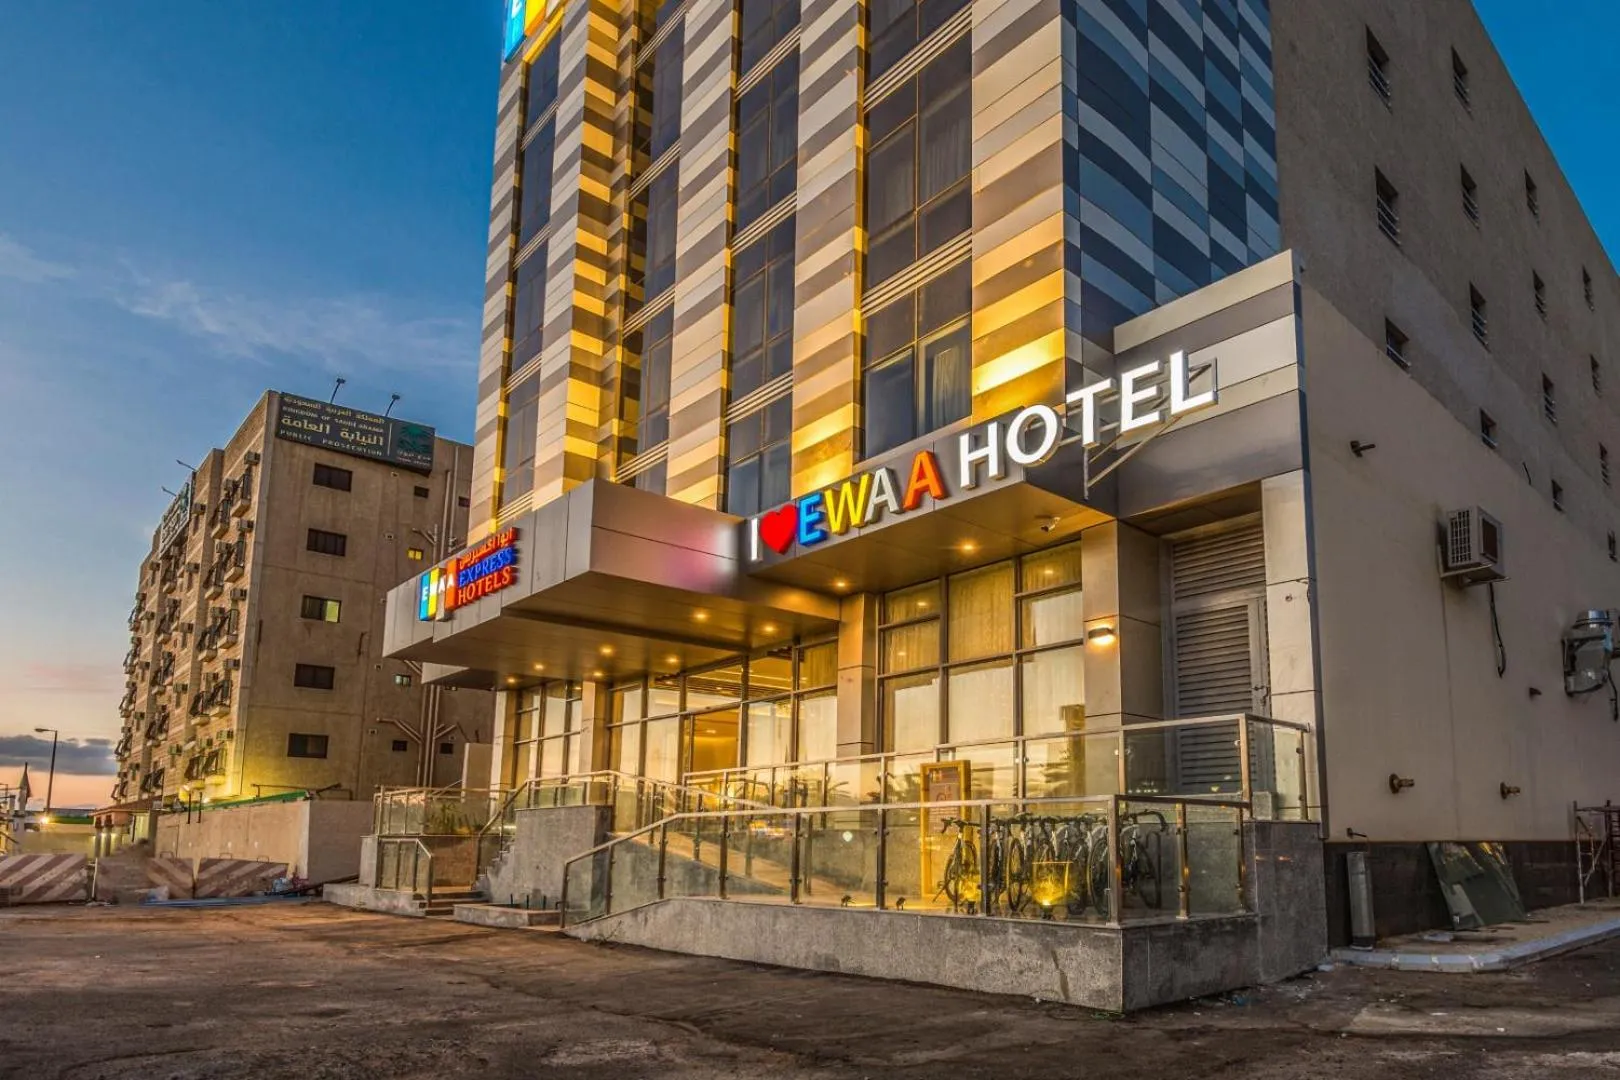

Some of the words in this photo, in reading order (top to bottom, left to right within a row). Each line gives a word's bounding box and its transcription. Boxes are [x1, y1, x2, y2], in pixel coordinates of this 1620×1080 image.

[281, 416, 330, 434] العامة
[340, 429, 384, 446] النيابة
[750, 518, 761, 561] I
[797, 451, 945, 545] EWAA
[959, 350, 1218, 489] HOTEL
[459, 547, 512, 587] EXPRESS
[422, 573, 454, 600] EAA
[458, 566, 510, 605] HOTELS
